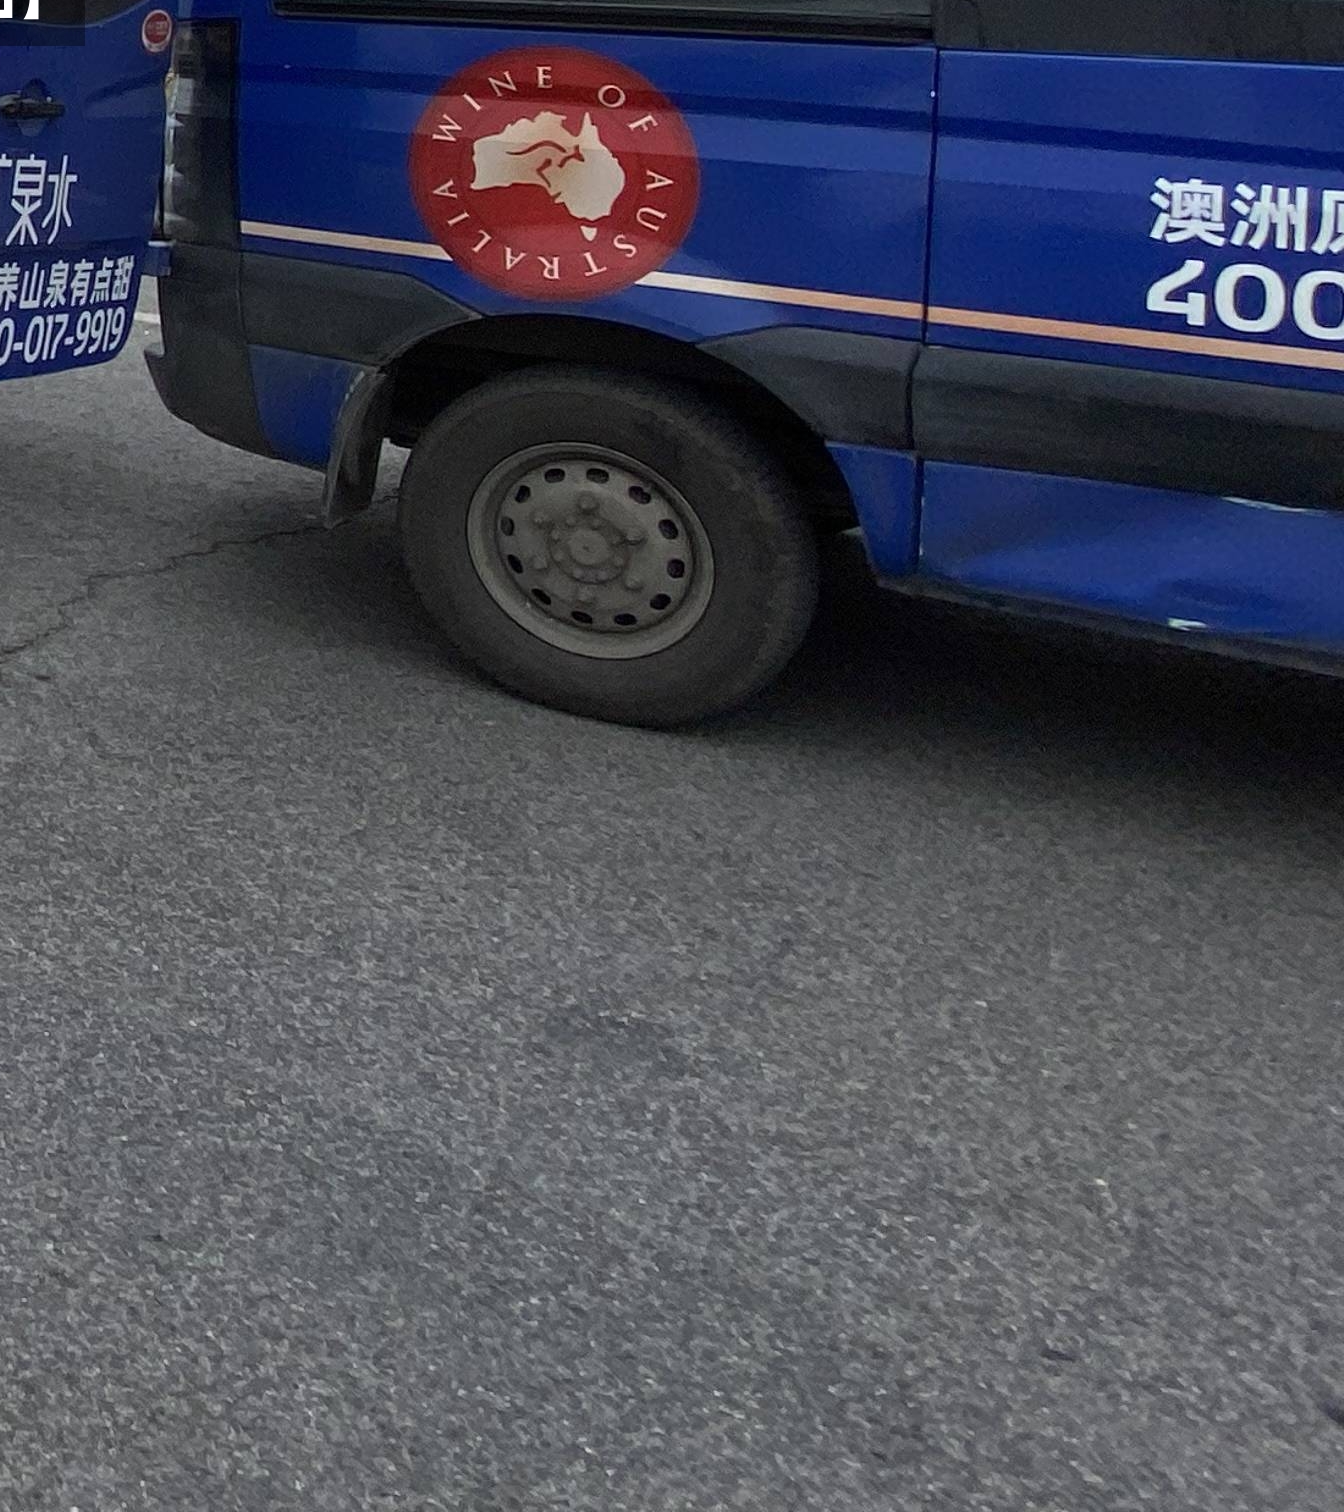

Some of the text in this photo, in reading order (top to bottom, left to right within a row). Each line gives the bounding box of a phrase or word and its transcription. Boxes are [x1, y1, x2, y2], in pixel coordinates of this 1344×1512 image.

[431, 65, 674, 281] WINE OF AUSTRALIA
[1146, 259, 1344, 341] 400
